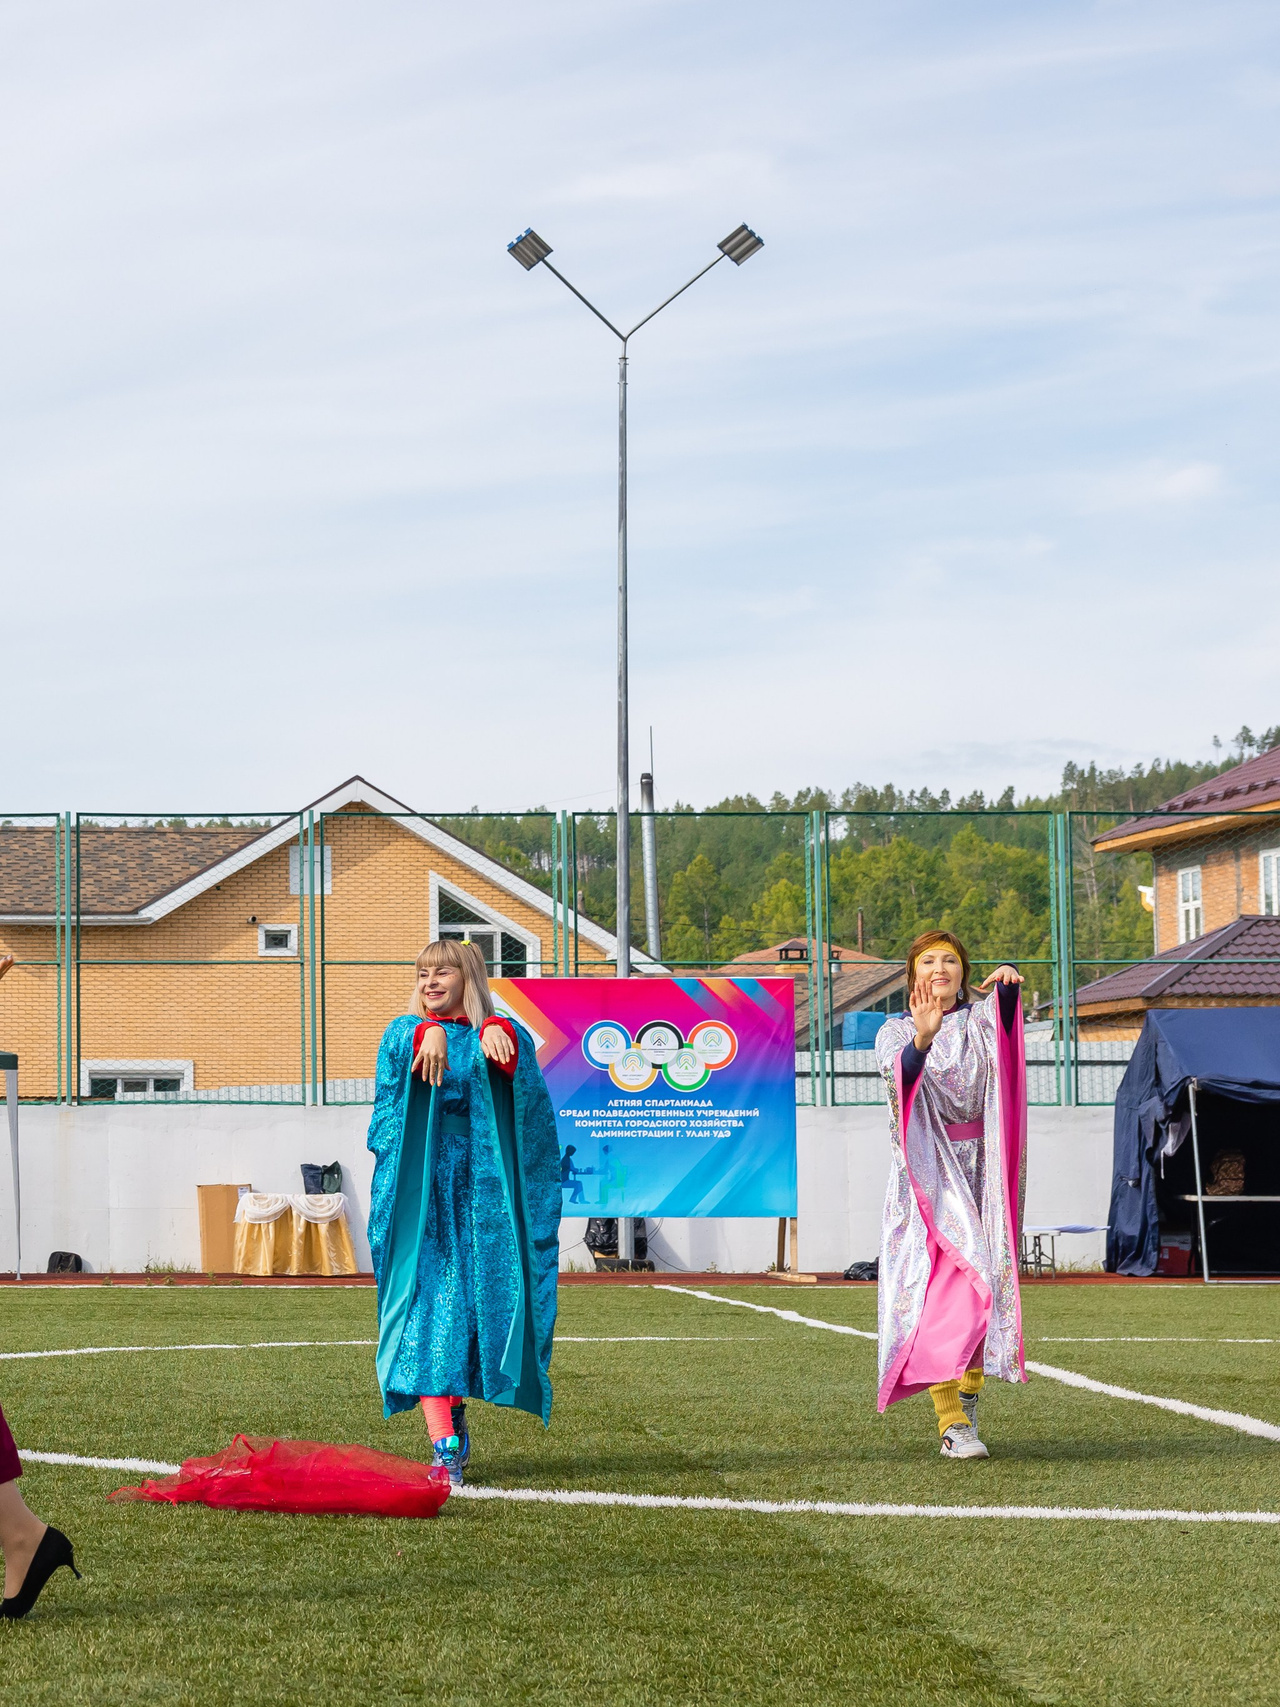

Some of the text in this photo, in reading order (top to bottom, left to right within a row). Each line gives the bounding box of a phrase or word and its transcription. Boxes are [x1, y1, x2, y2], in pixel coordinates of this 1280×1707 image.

[608, 1099, 713, 1107] ЛЕТНЯЯ СПАРТАКИАДА
[559, 1108, 760, 1118] СРЕДИ ПОДВЕДОМСТВЕННЫХ УЧРЕЖДЕНИЙ
[575, 1118, 744, 1128] КОМИТЕТА ГОРОДСКОГО ХОЗЯЙСТВА
[590, 1130, 732, 1138] АДМИНИСТРАЦИИ Г. УЛАН-УДЭ
